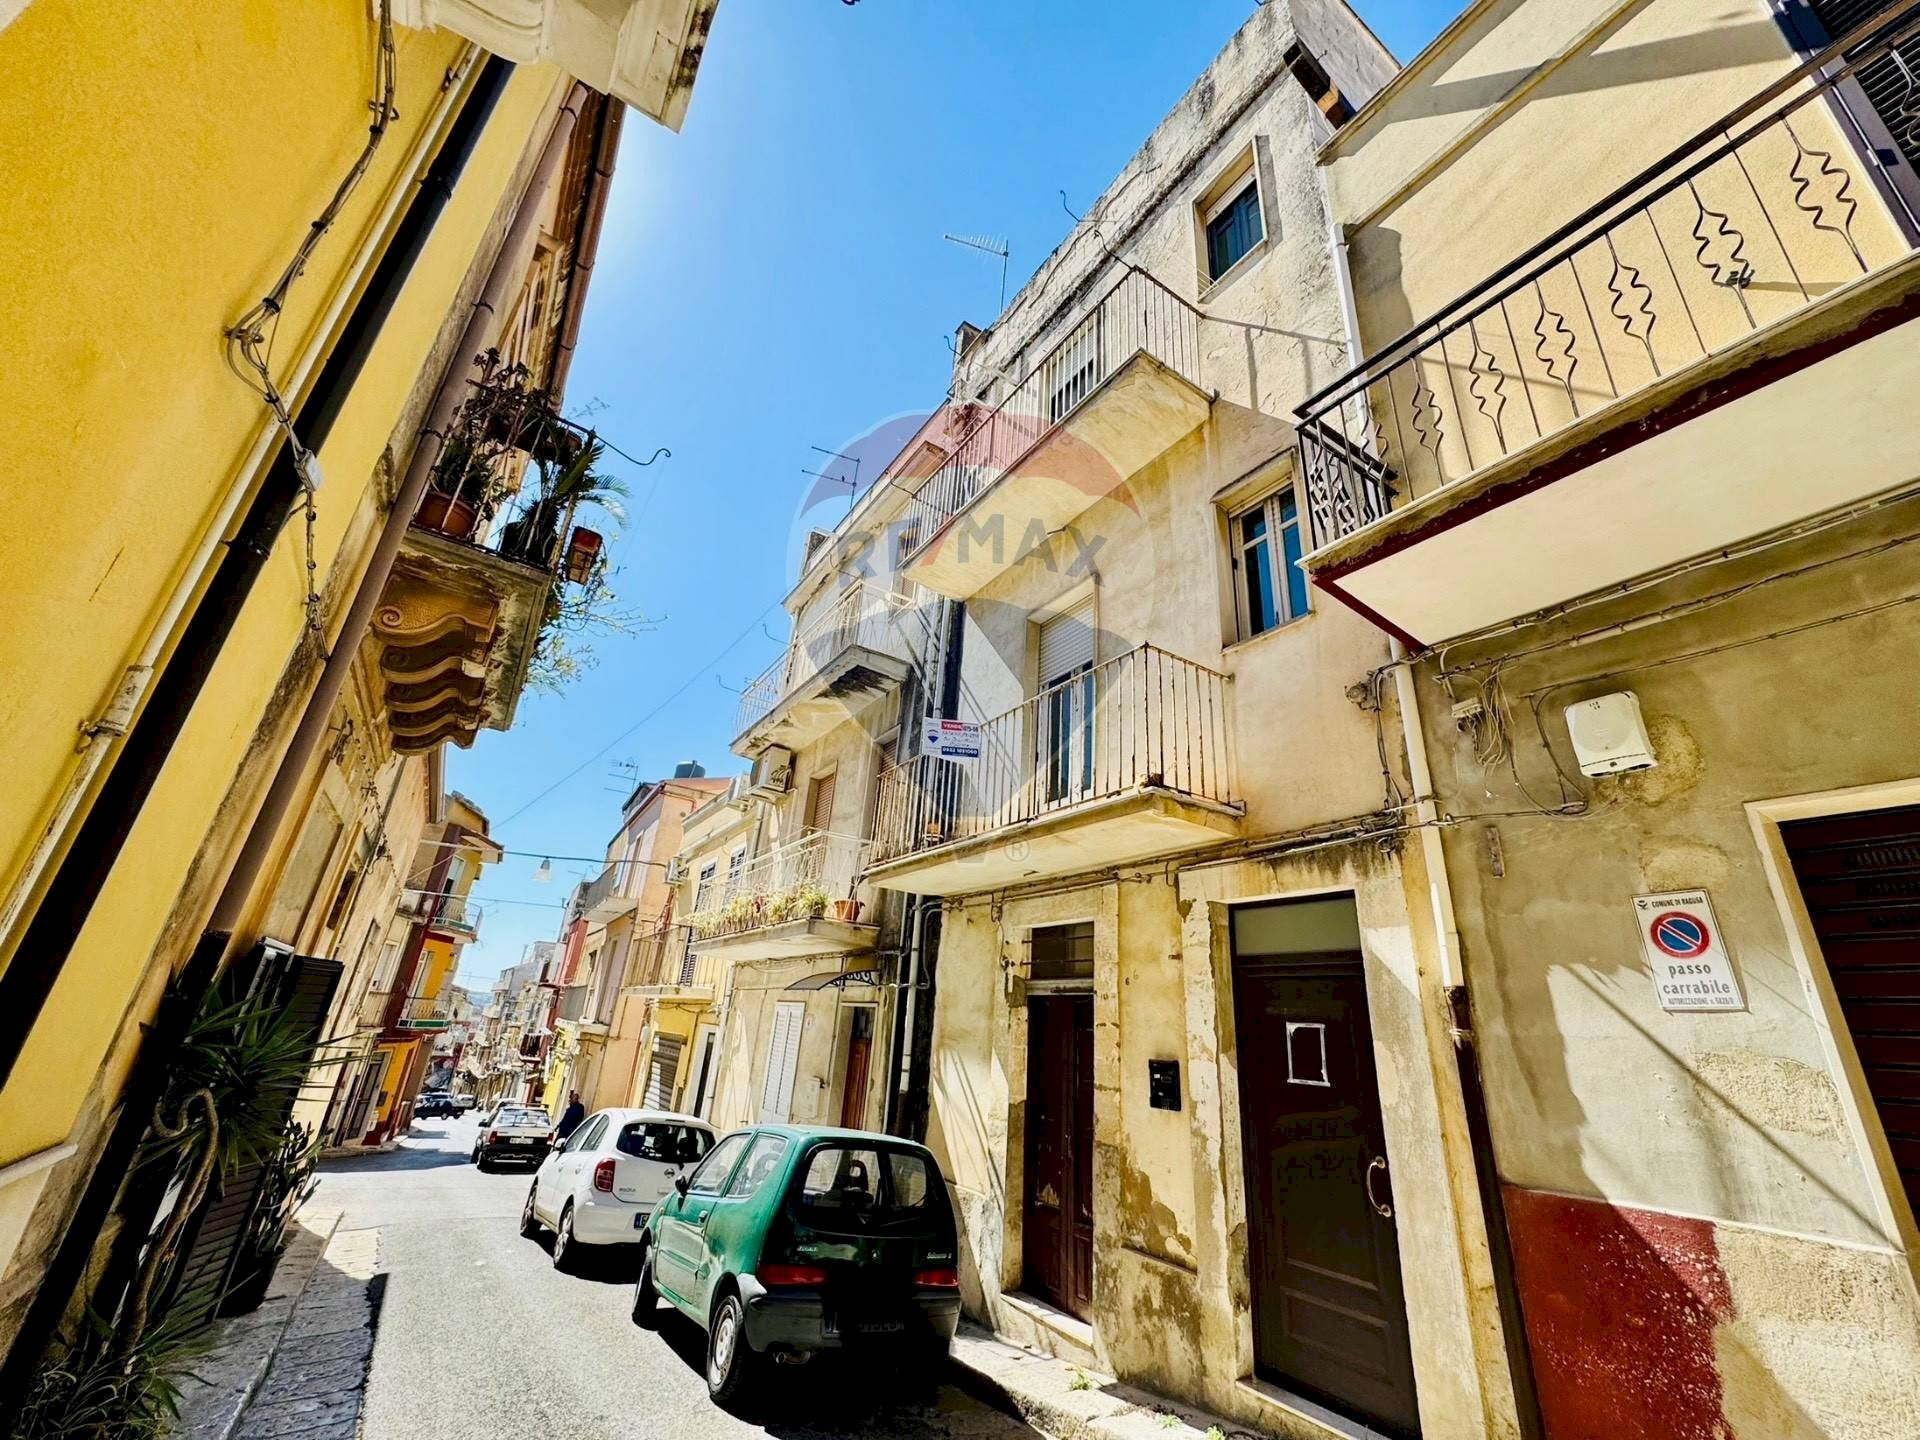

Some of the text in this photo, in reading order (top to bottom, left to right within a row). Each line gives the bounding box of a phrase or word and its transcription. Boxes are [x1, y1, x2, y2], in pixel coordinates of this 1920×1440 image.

[1652, 899, 1674, 908] COMUNE
[1681, 897, 1704, 905] RAGUSA
[1668, 964, 1712, 978] passo
[1663, 980, 1730, 995] carrabile
